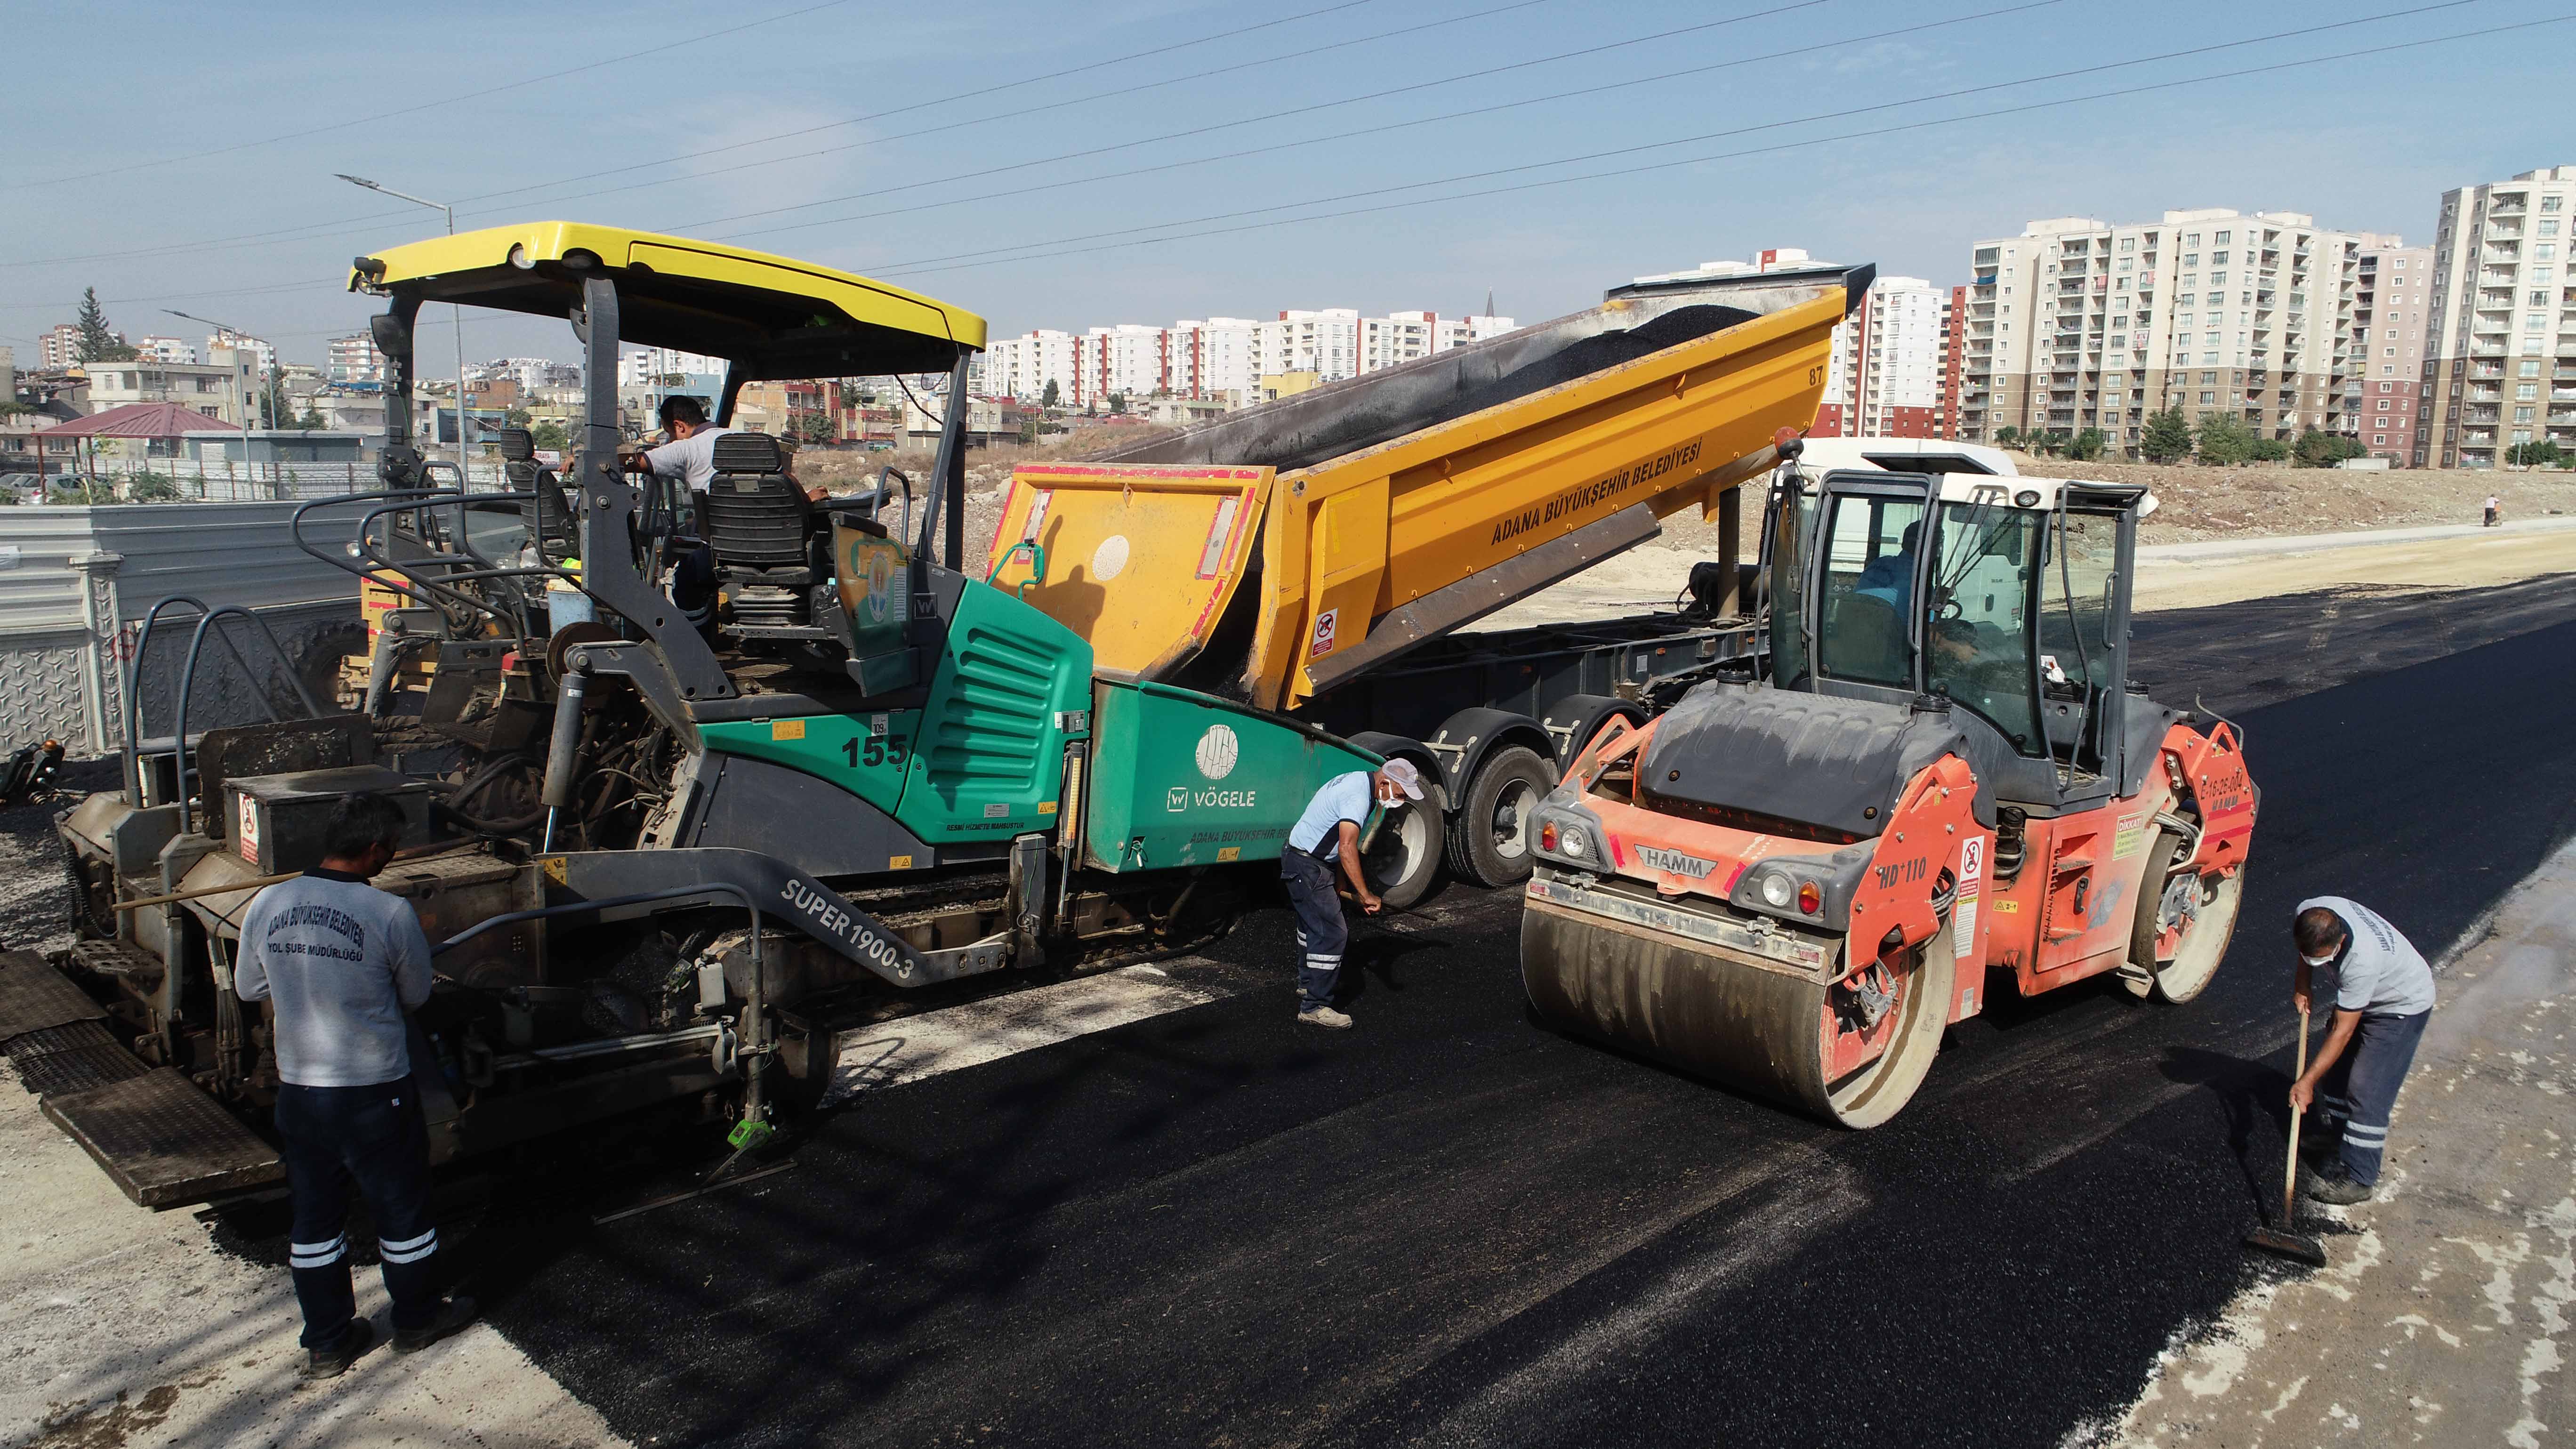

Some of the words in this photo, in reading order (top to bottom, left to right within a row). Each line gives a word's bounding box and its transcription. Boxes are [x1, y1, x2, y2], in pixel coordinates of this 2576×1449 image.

[1809, 365, 1823, 386] 87
[1491, 507, 1540, 546] ADANA
[1544, 469, 1630, 524] BÜYÜKŞEHİR
[1632, 436, 1703, 486] BELEDİYESİ
[842, 734, 908, 768] 155
[1194, 786, 1256, 807] VÖGELE
[1190, 831, 1219, 844] ADANA
[1221, 828, 1275, 842] BÜYÜKŞEHİR
[1647, 850, 1703, 877] HAMM
[267, 909, 290, 941] ADANA
[289, 901, 331, 930] BÜYÜKŞEHİR
[330, 908, 366, 950] BELEDİYESİ
[781, 879, 850, 937] SUPER
[849, 925, 915, 979] 1900-3
[268, 942, 283, 953] YOL
[285, 942, 306, 956] ŞUBE
[307, 943, 363, 962] MÜDÜRLÜĞÜ
